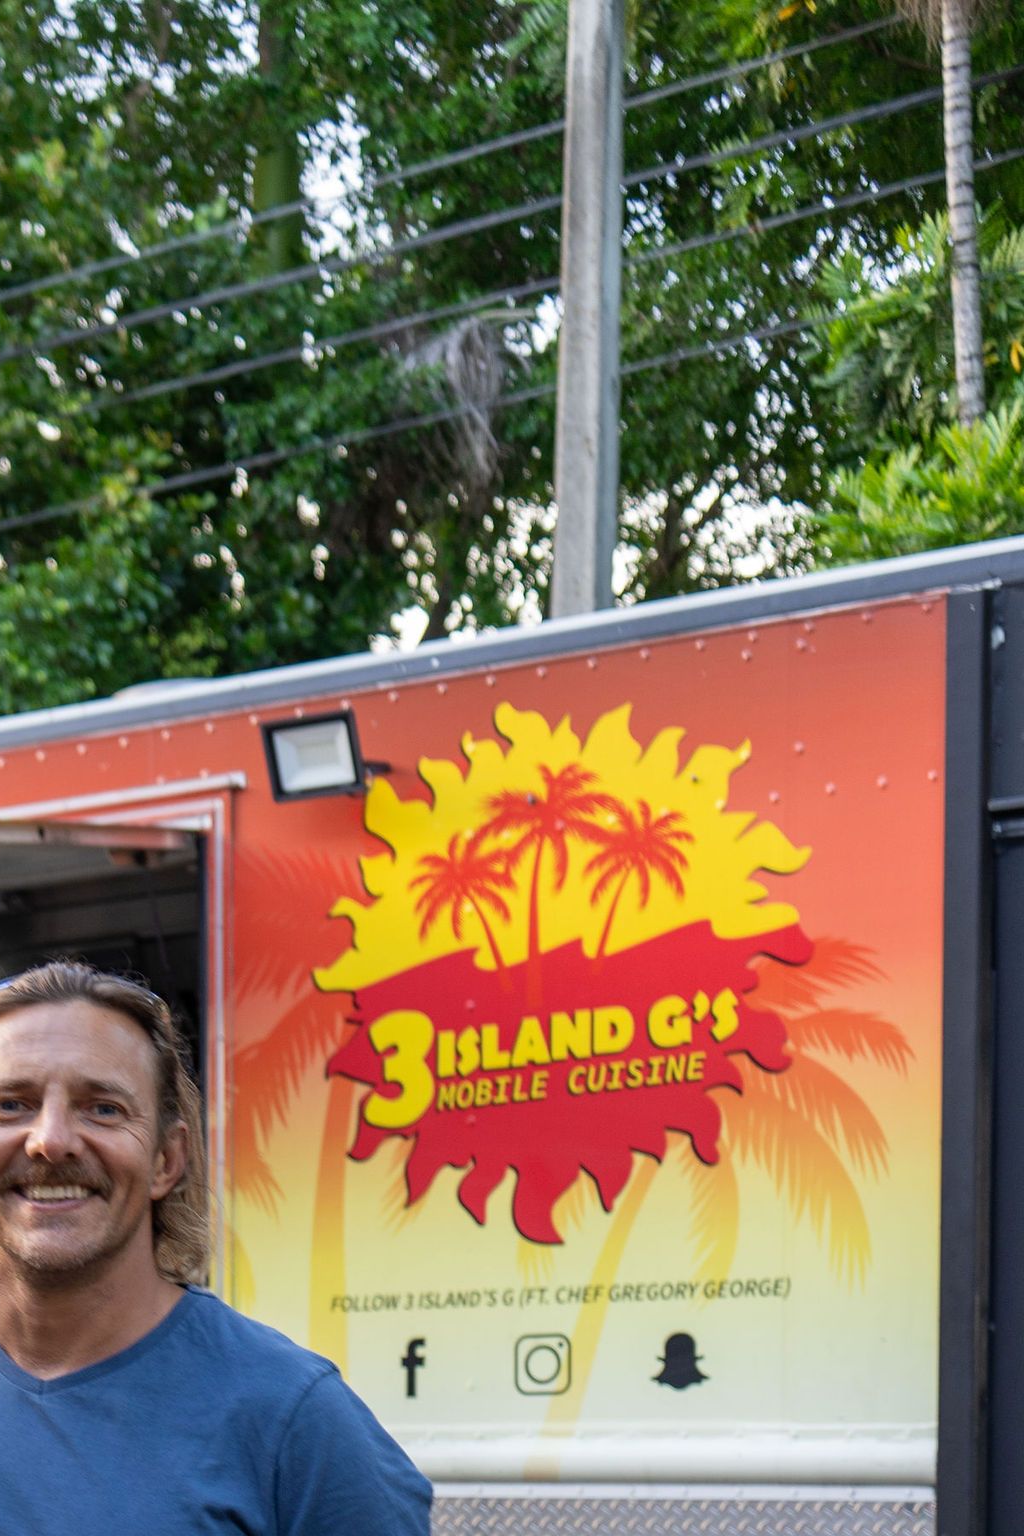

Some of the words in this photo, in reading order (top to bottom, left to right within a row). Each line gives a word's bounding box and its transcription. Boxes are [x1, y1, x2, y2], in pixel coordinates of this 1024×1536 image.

[363, 1009, 435, 1128] 3
[437, 1005, 635, 1078] ISLAND
[647, 986, 740, 1048] G'S
[436, 1071, 549, 1112] MOBILE
[567, 1051, 706, 1095] CUISINE
[331, 1293, 400, 1312] FOLLOW
[404, 1294, 414, 1310] 3
[419, 1290, 497, 1309] ISLAND'S
[502, 1289, 514, 1307] G
[519, 1287, 548, 1309] (FT.
[555, 1285, 604, 1304] CHEF
[609, 1280, 698, 1303] GREGORY
[703, 1276, 791, 1300] GEORGE)
